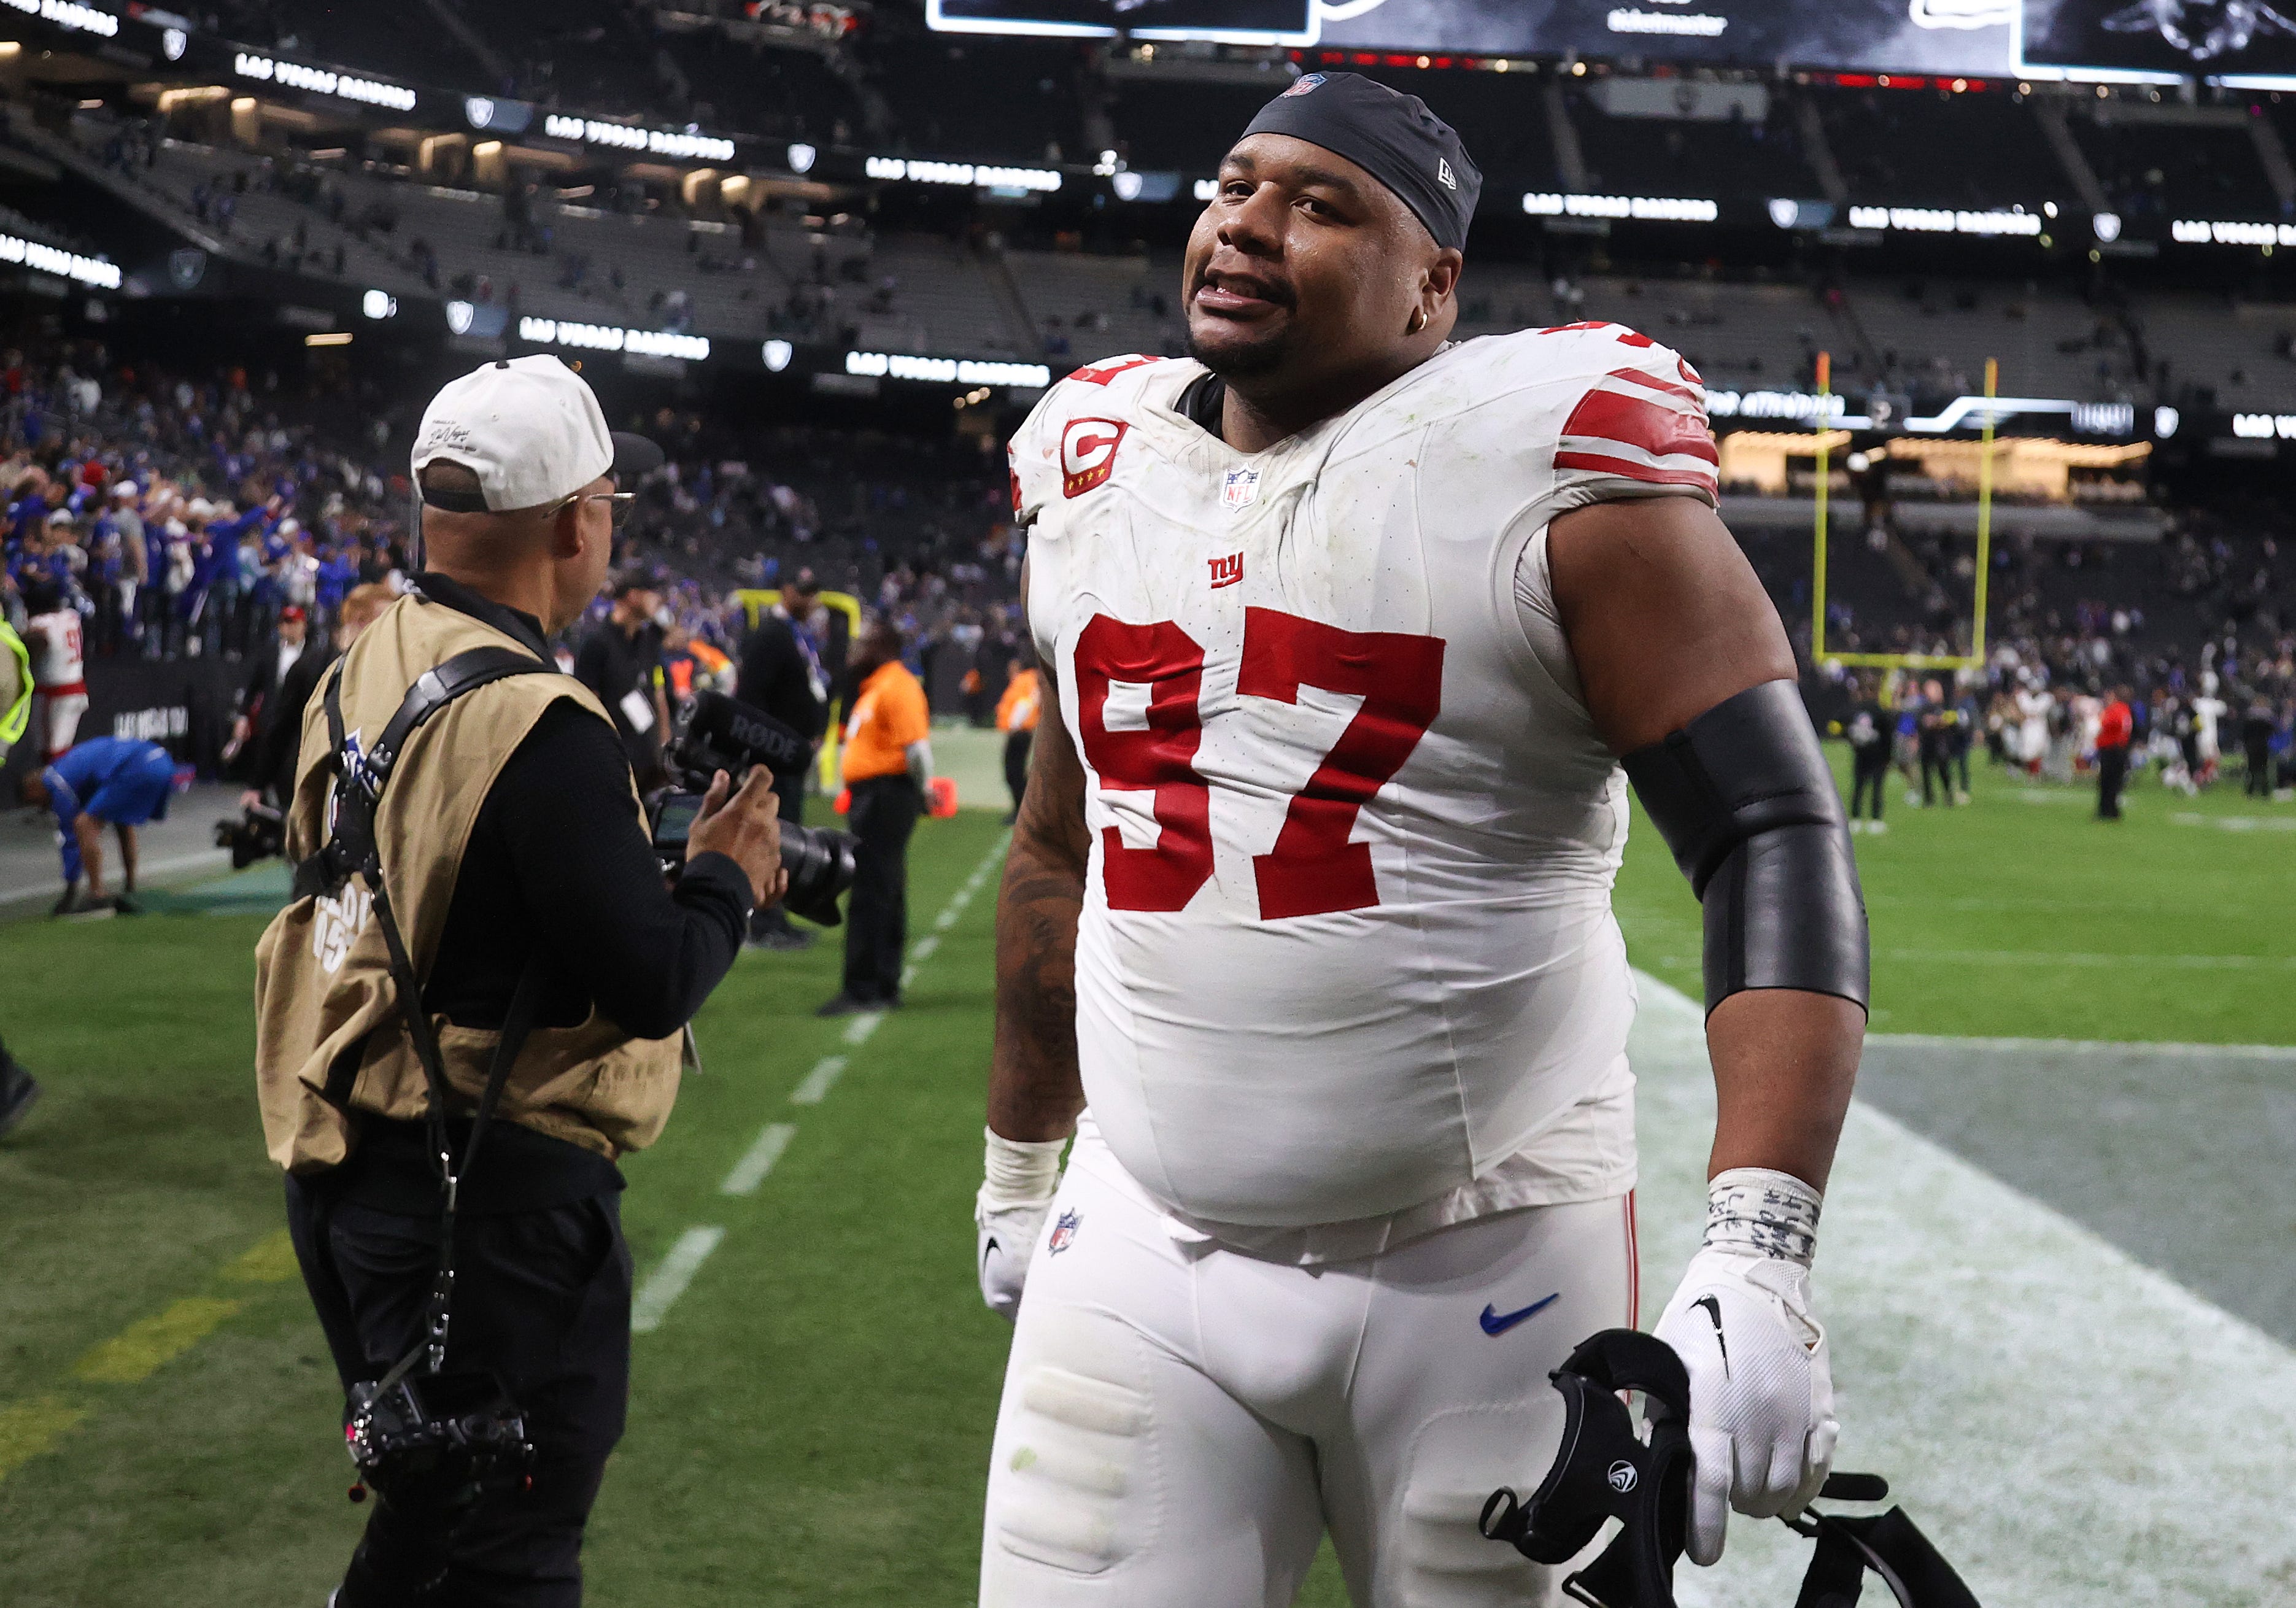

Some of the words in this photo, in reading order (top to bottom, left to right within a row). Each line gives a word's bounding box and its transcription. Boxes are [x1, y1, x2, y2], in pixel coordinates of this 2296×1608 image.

[235, 52, 274, 79] LAS
[545, 114, 585, 140] LAS
[1064, 421, 1119, 474] C
[1227, 485, 1251, 502] NFL
[1073, 606, 1446, 921] 97
